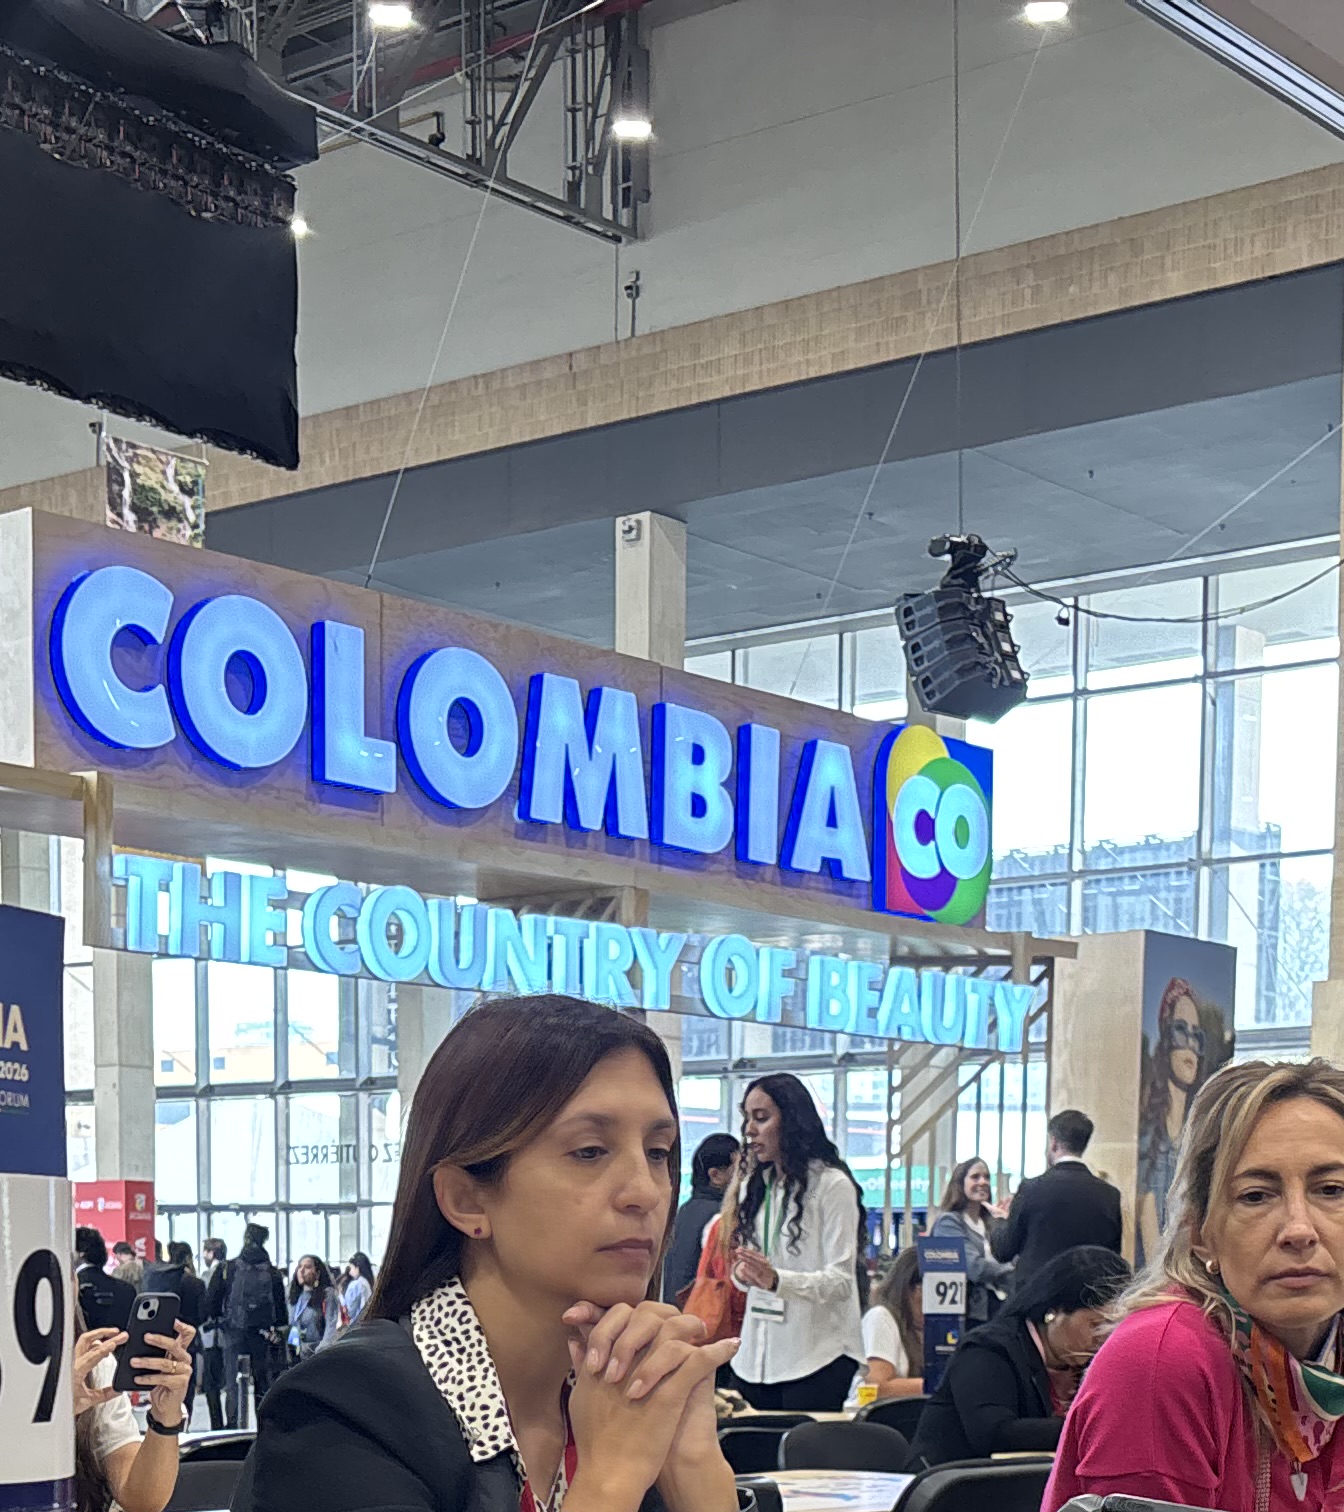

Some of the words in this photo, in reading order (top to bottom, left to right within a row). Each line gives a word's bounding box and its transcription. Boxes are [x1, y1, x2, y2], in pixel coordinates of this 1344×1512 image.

[50, 565, 872, 882] COLOMBIA
[892, 773, 988, 881] CO
[114, 852, 290, 968] THE
[302, 883, 684, 1011] COUNTRY
[701, 933, 801, 1025] OF
[807, 955, 1034, 1053] BEAUTY
